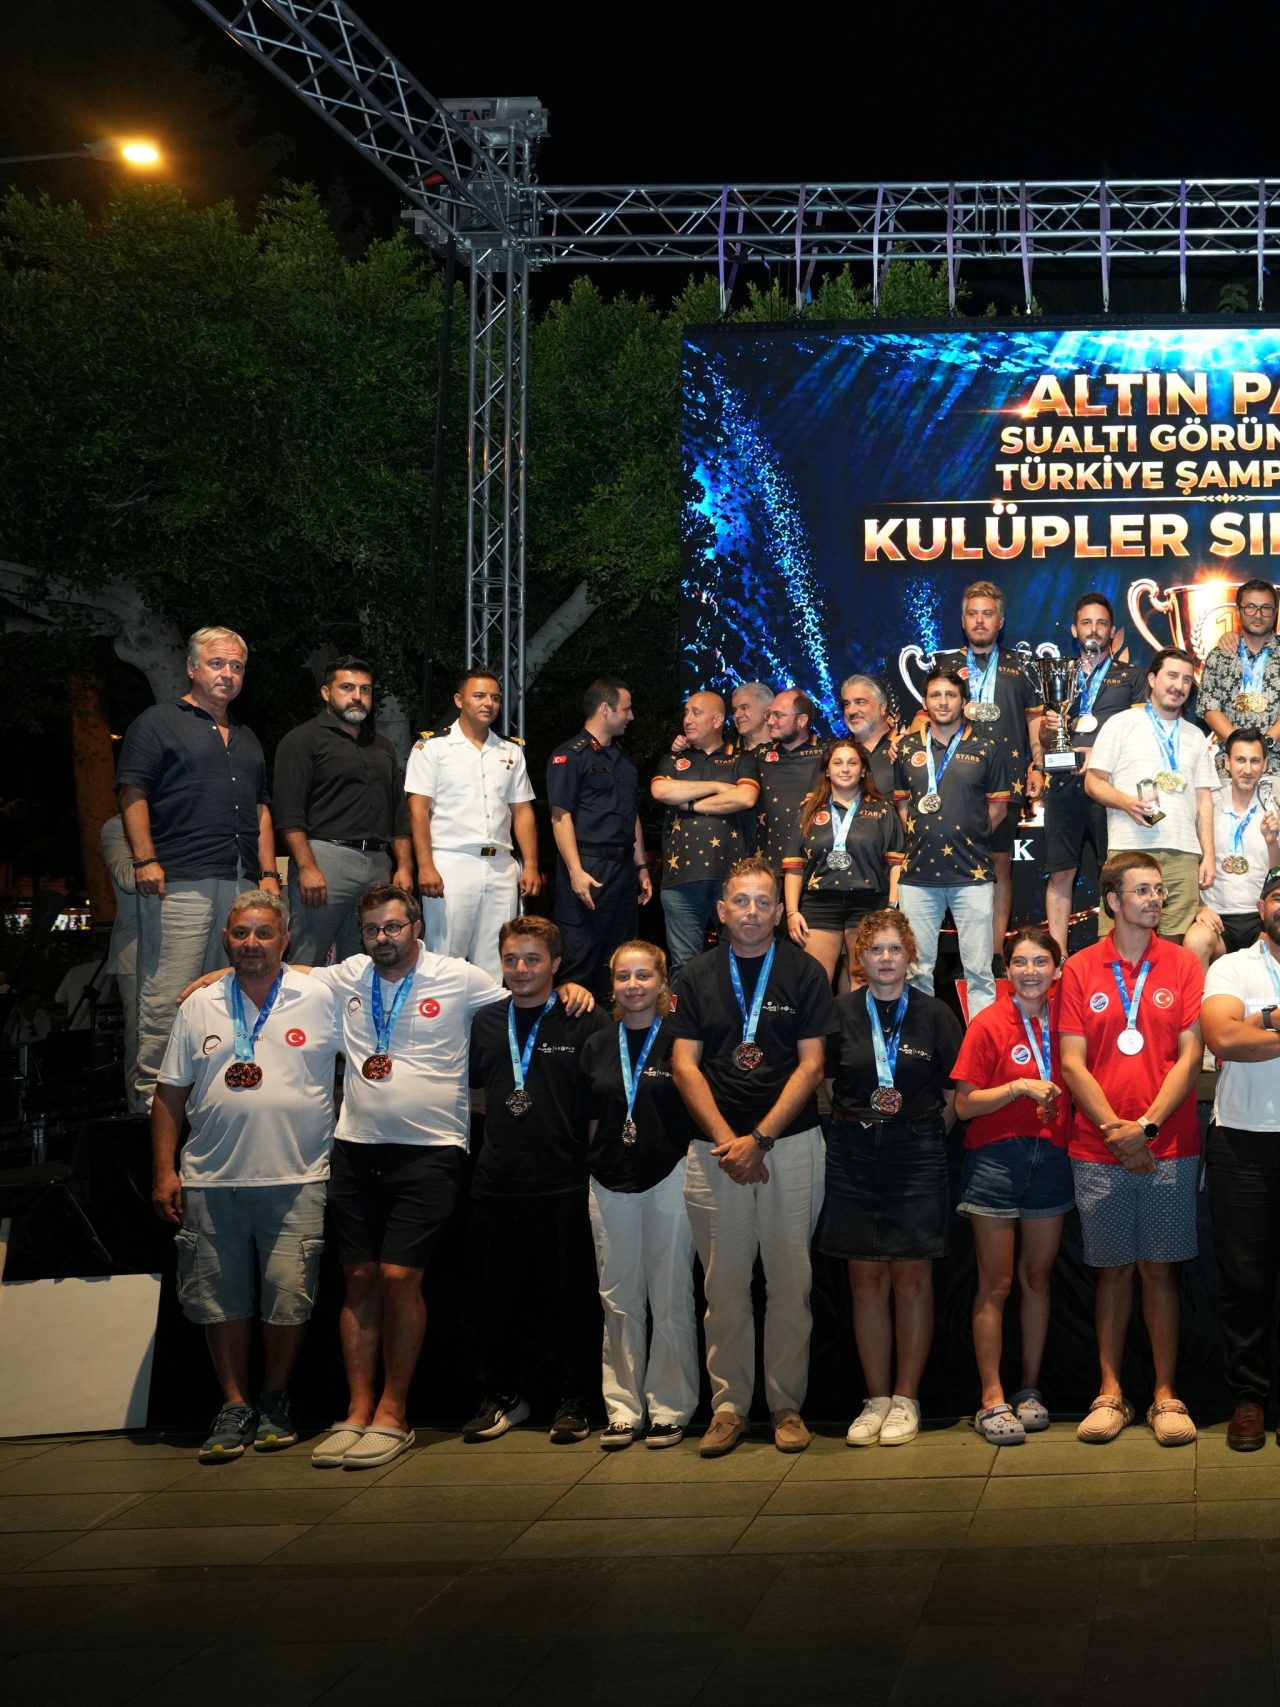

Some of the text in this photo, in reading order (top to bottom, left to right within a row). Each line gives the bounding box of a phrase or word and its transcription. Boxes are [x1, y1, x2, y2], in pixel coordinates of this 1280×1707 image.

[1026, 372, 1208, 418] ALTIN
[1000, 425, 1138, 454] SUALTI
[995, 454, 1164, 491] TÜRKİYE
[863, 503, 1190, 561] KULÜPLER
[955, 753, 980, 763] STARS
